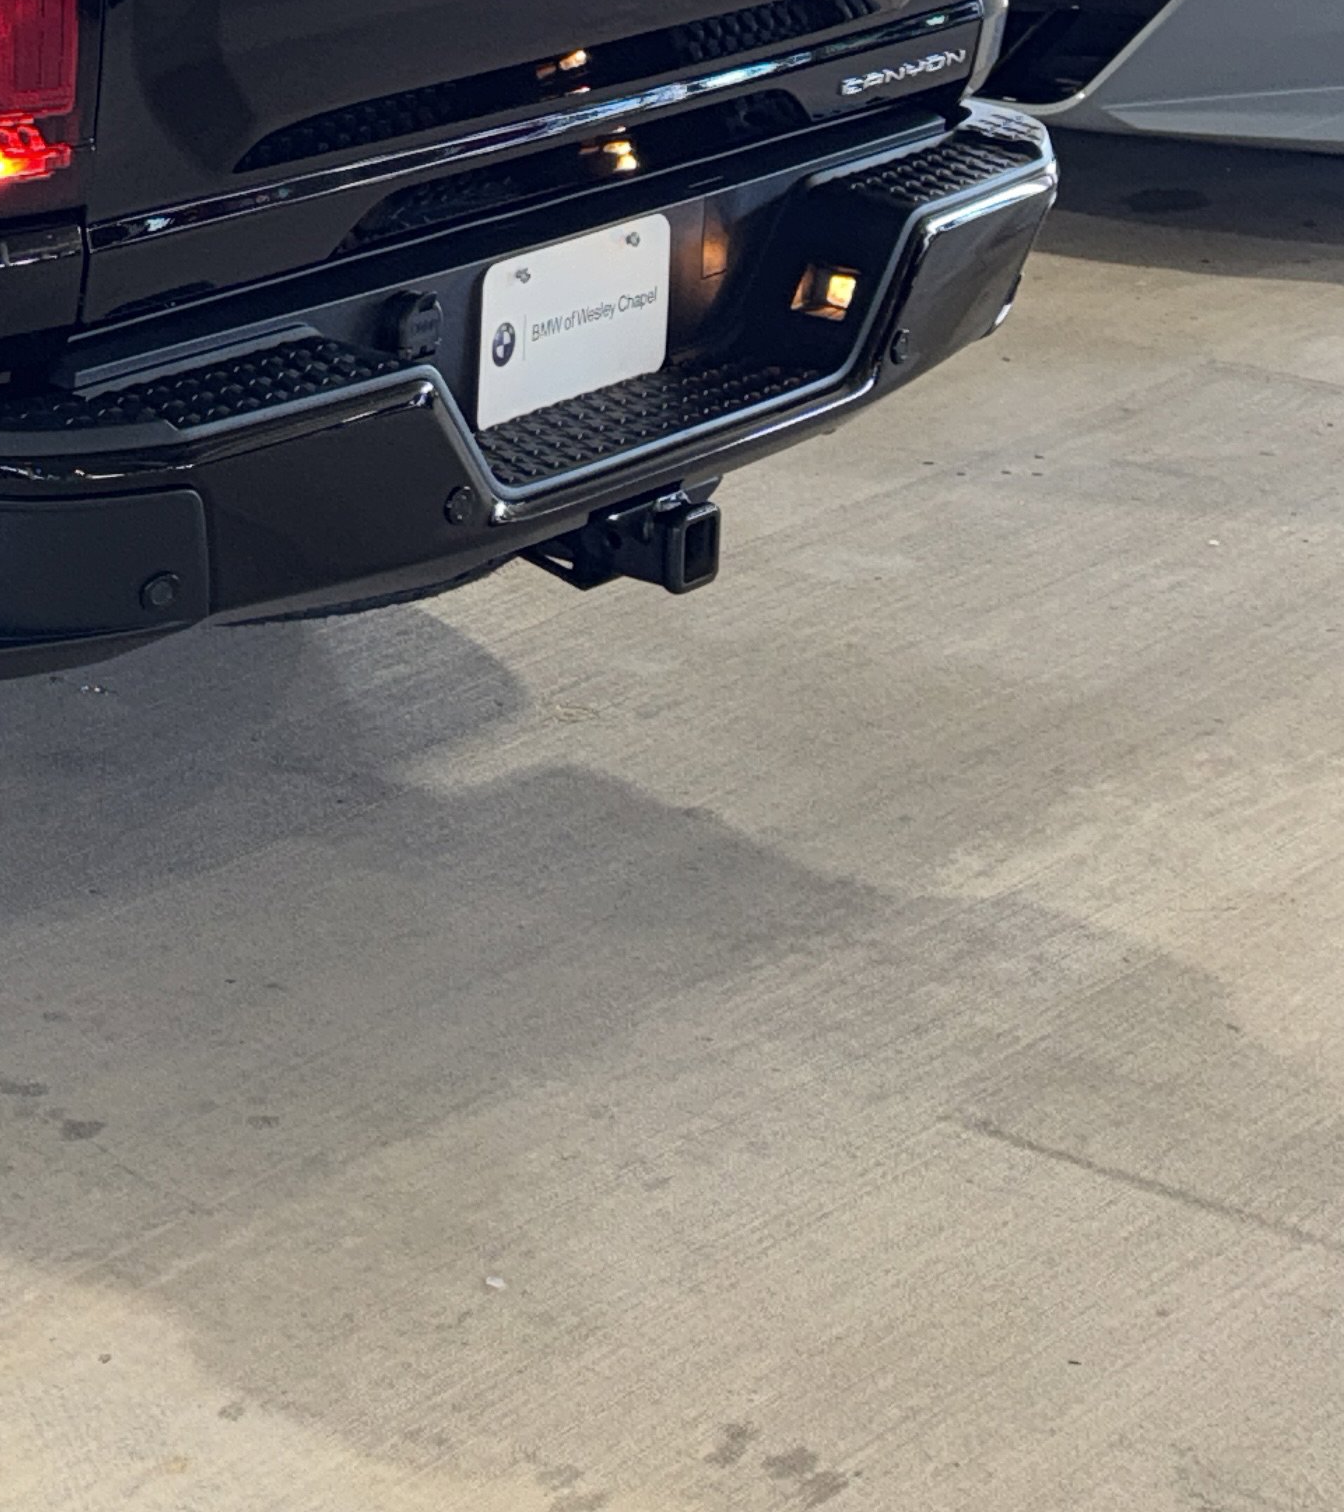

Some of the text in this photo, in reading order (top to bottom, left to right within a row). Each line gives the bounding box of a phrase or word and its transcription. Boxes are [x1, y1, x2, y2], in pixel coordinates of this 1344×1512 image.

[840, 49, 966, 96] CANYON
[531, 285, 657, 342] BMW of Wesley Chapel
